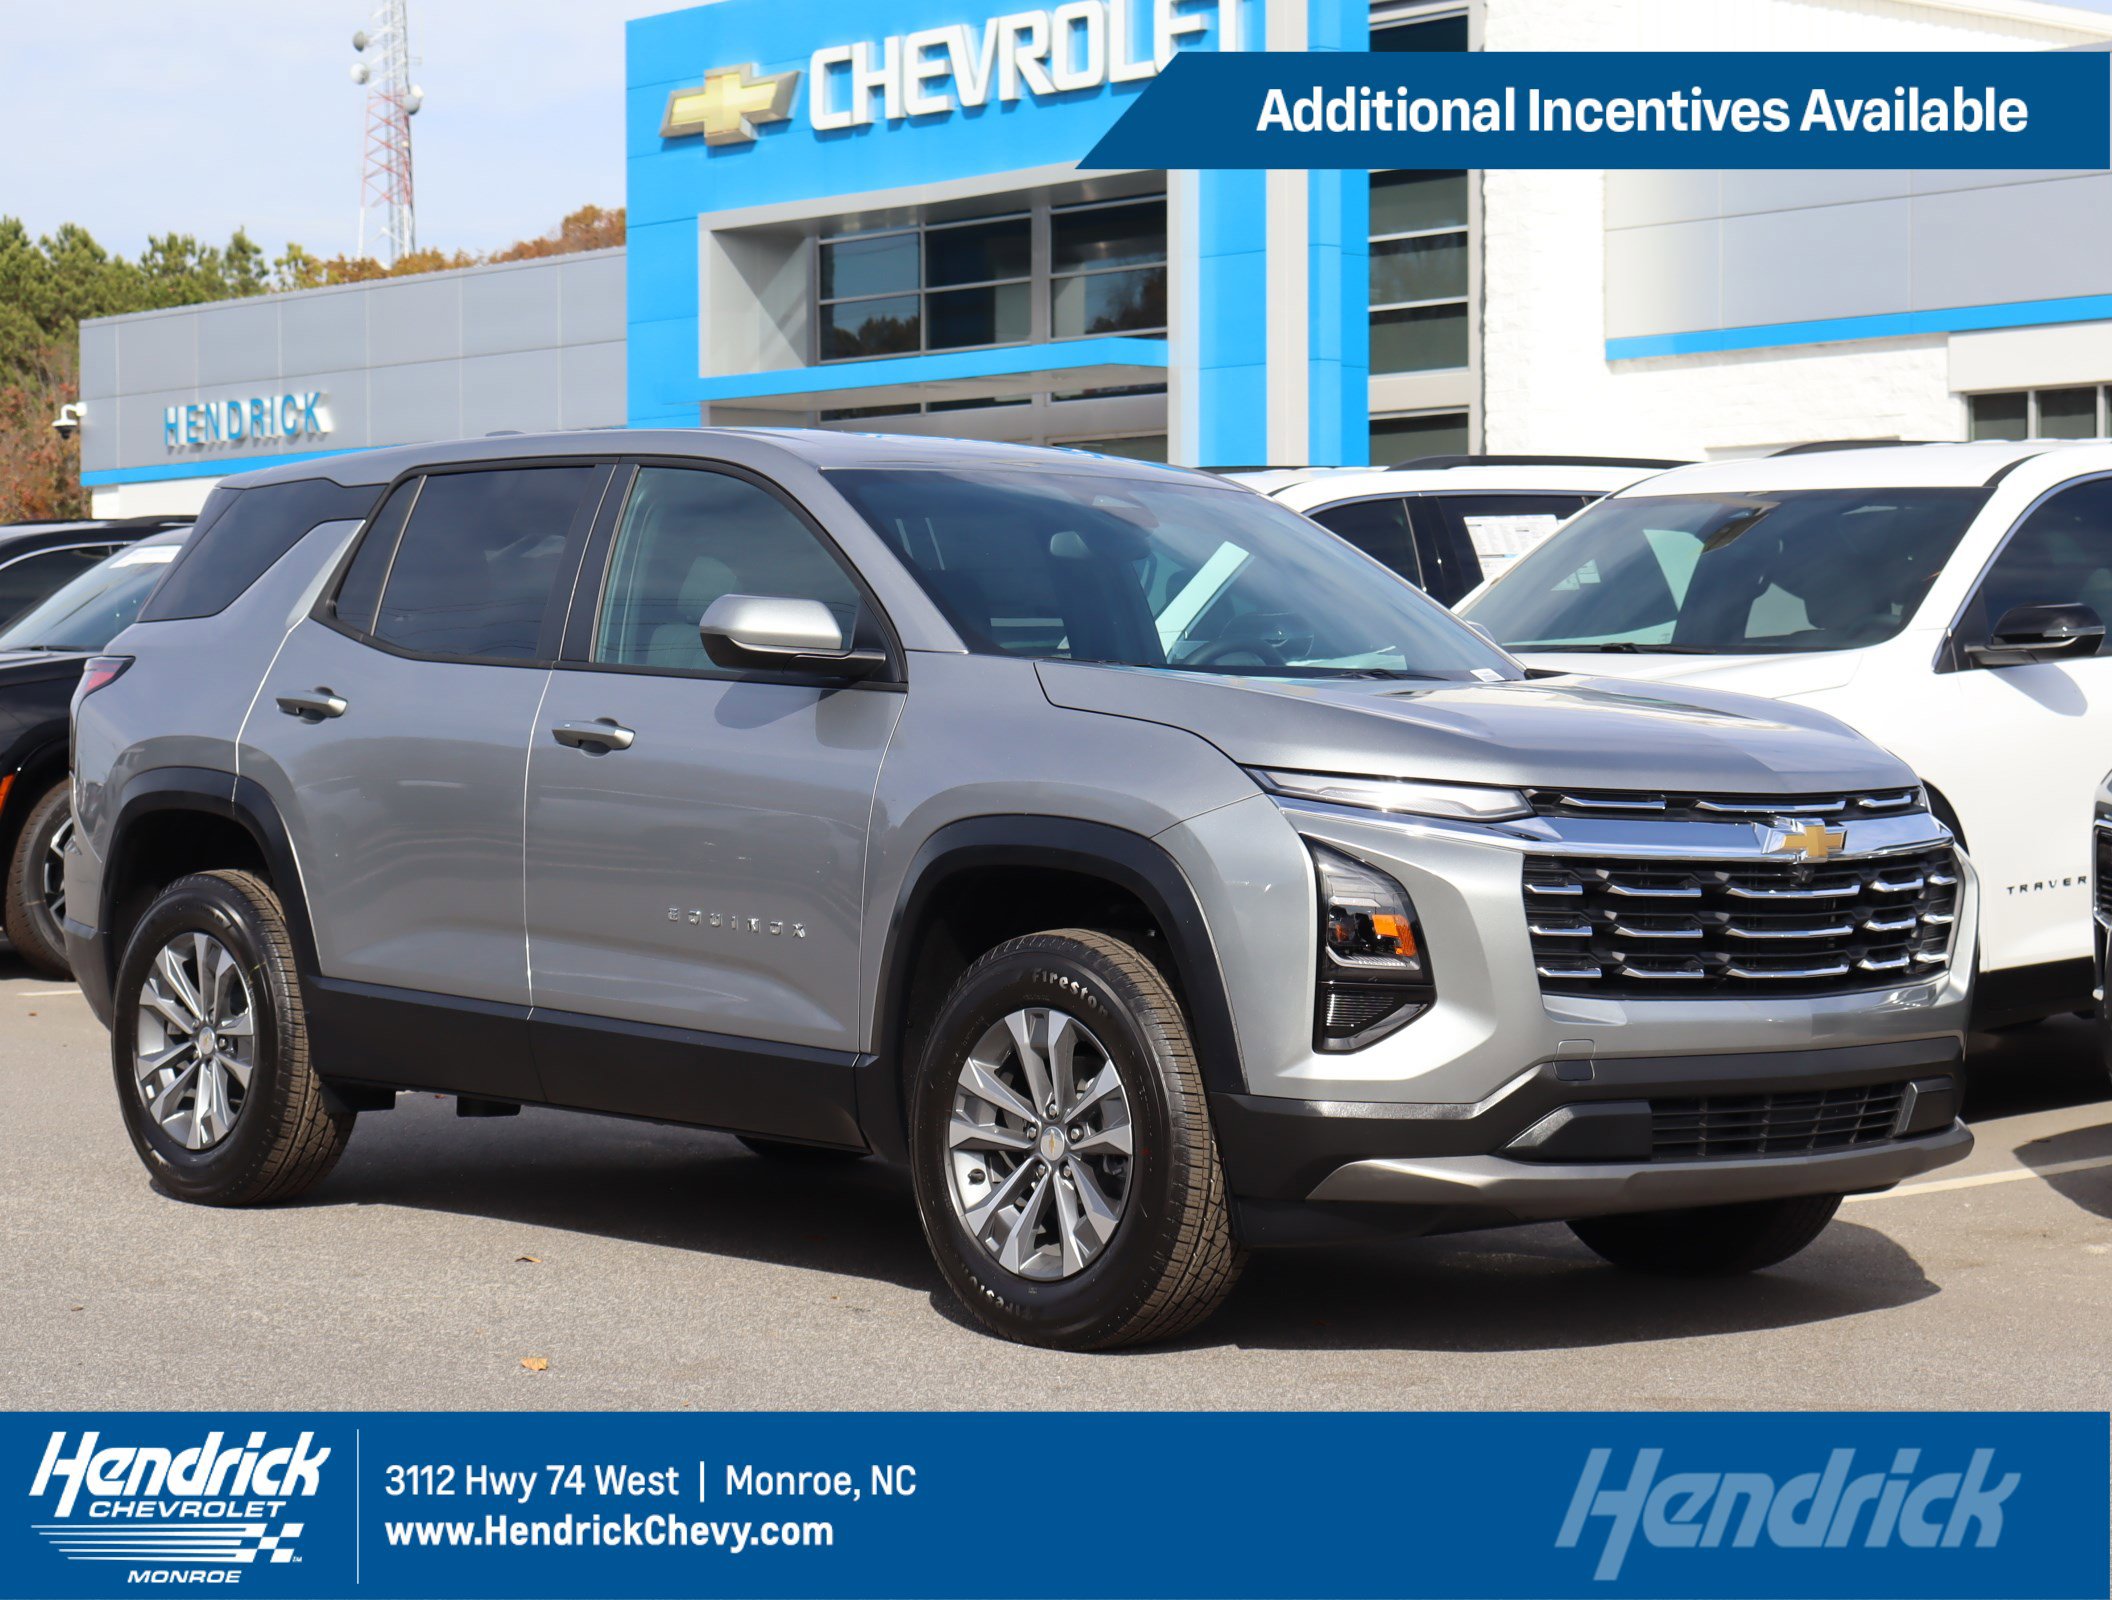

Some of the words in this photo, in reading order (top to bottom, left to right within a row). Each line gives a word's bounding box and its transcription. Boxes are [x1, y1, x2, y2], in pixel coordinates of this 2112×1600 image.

[164, 391, 327, 446] HENDRICK
[668, 907, 806, 938] EQUINOX
[1032, 967, 1109, 1017] Fireston
